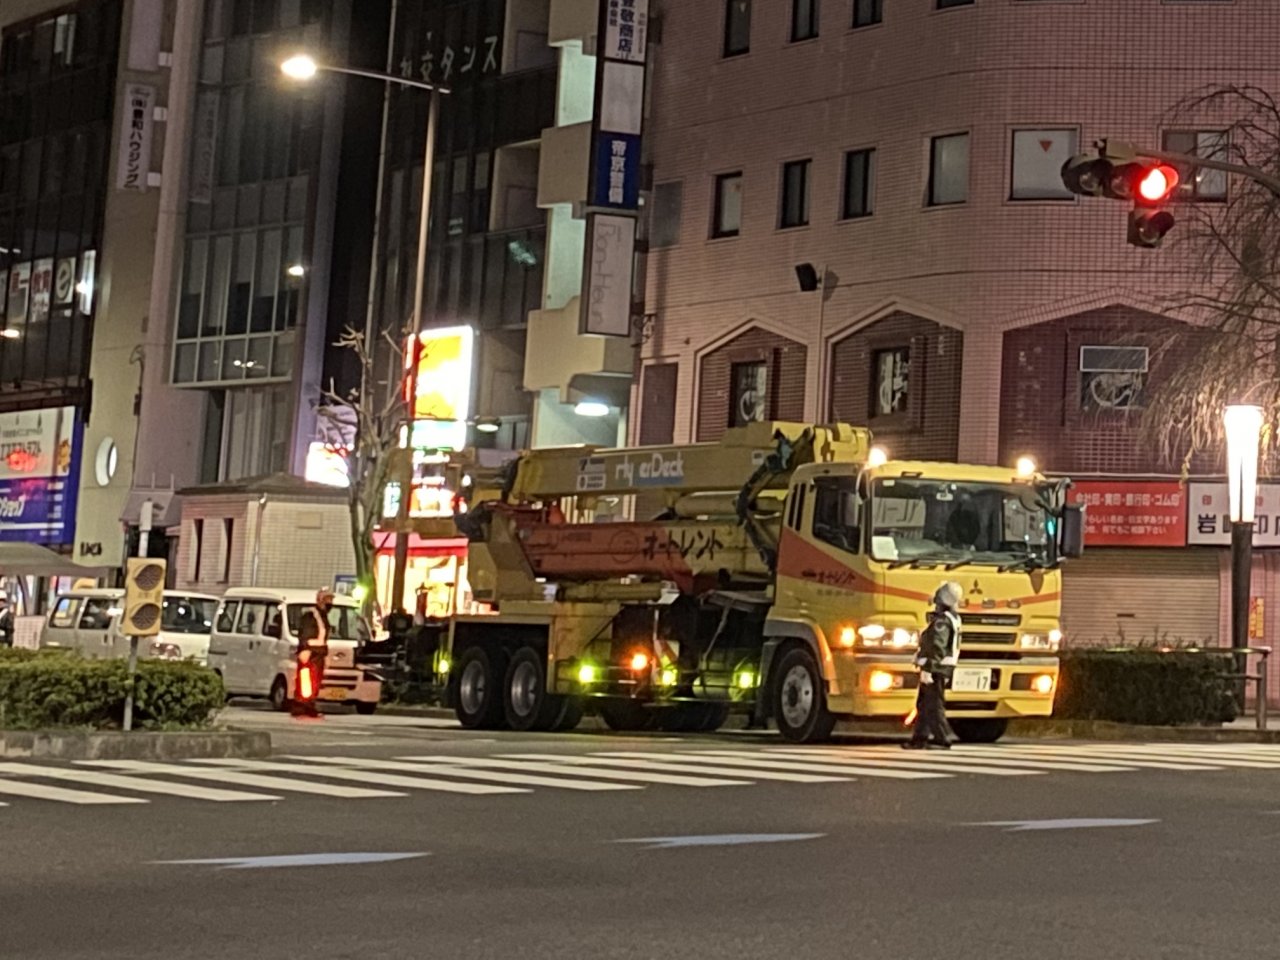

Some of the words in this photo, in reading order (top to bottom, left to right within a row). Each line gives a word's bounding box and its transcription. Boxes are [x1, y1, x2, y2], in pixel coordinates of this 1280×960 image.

[644, 530, 724, 560] オートレント
[977, 676, 989, 690] 17
